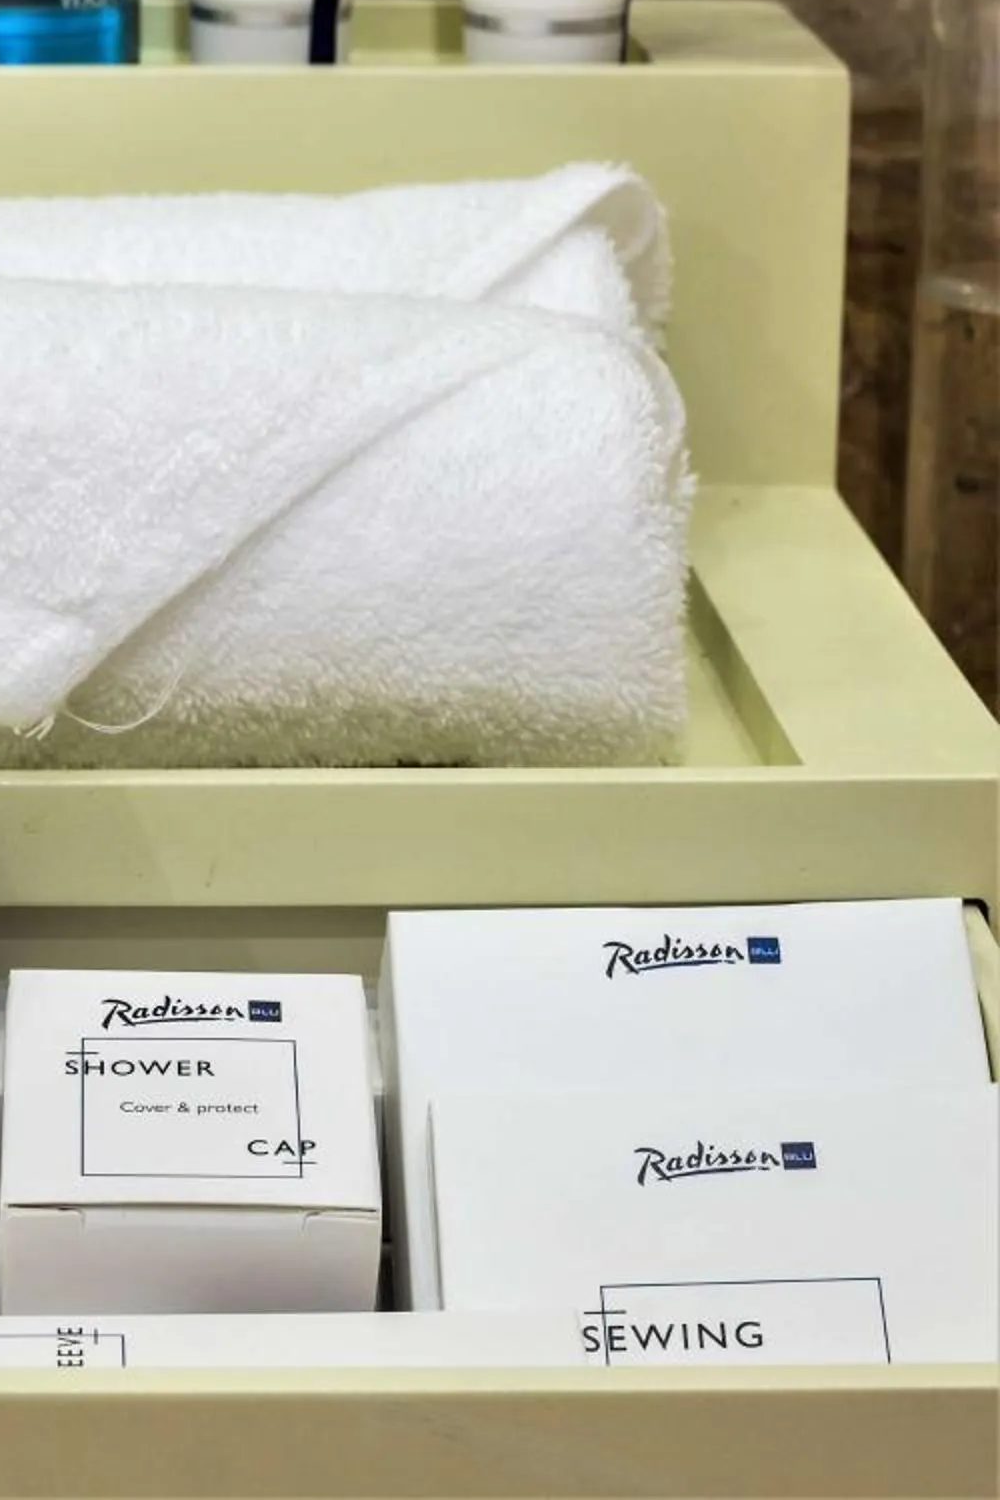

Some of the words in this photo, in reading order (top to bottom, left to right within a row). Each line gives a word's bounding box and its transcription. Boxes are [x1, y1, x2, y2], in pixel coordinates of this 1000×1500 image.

[602, 934, 745, 980] Radisson
[100, 995, 245, 1030] Radisson
[64, 1059, 216, 1077] SHOWER
[119, 1100, 172, 1114] Cover
[177, 1101, 191, 1114] &
[196, 1100, 259, 1117] protect
[246, 1138, 317, 1157] CAP
[633, 1140, 780, 1187] Radisson
[56, 1327, 83, 1367] EEVE
[582, 1321, 764, 1353] SEWING
